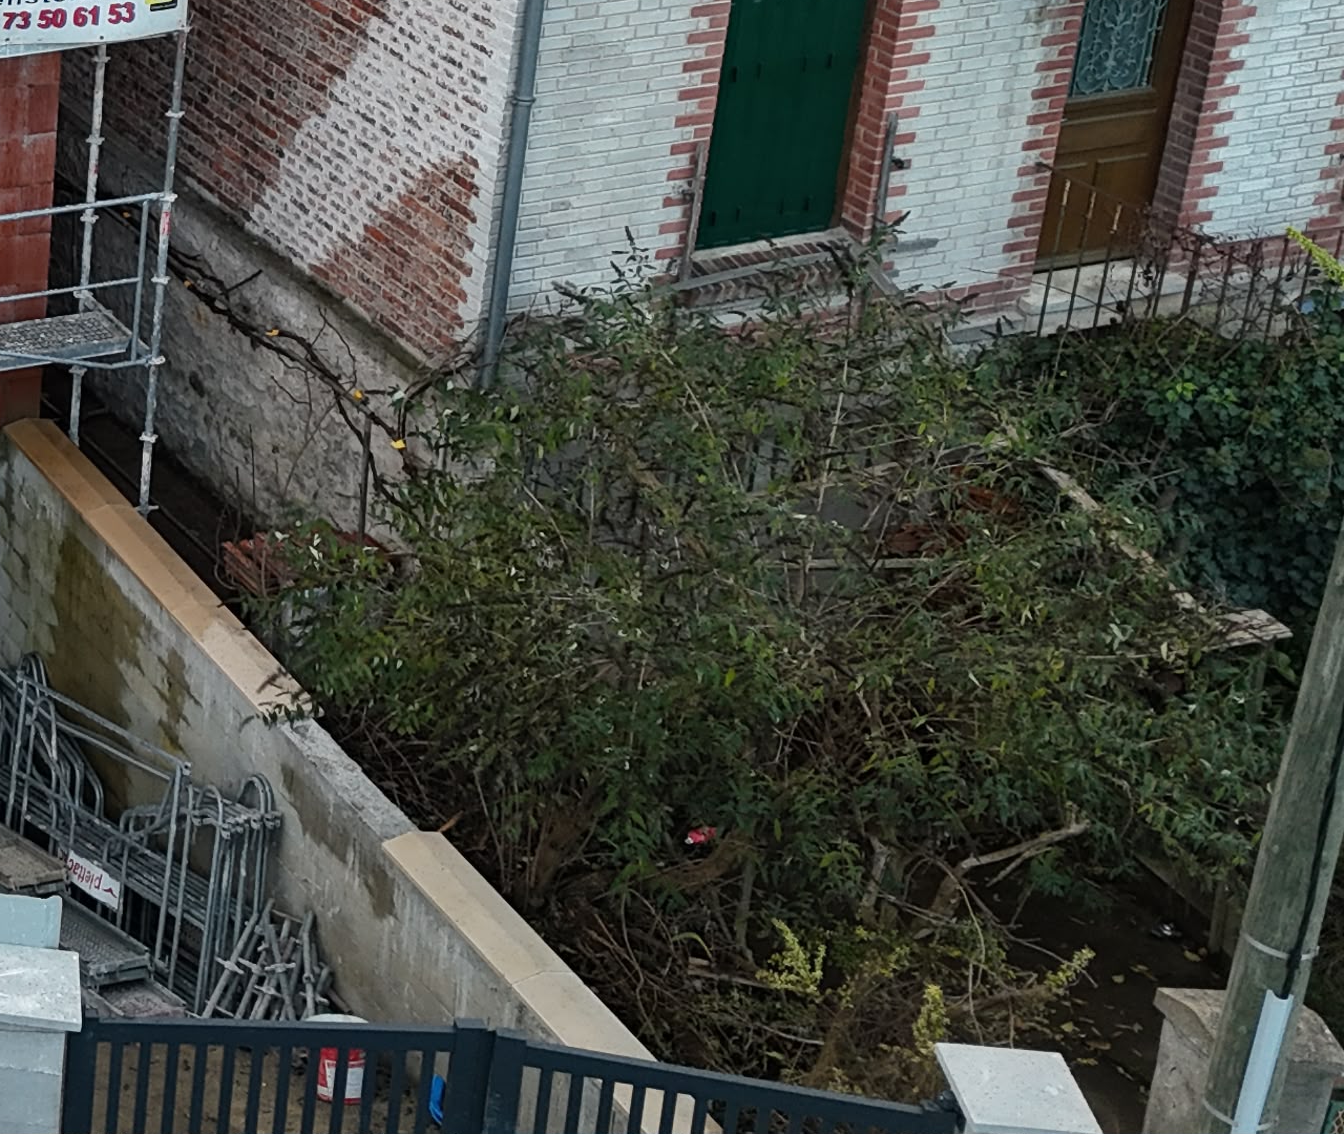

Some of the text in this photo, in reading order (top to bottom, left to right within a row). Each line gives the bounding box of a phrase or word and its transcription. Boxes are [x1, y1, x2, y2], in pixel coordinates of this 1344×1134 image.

[3, 11, 32, 30] 73
[37, 7, 67, 29] 50
[73, 5, 100, 27] 61
[108, 2, 136, 24] 53
